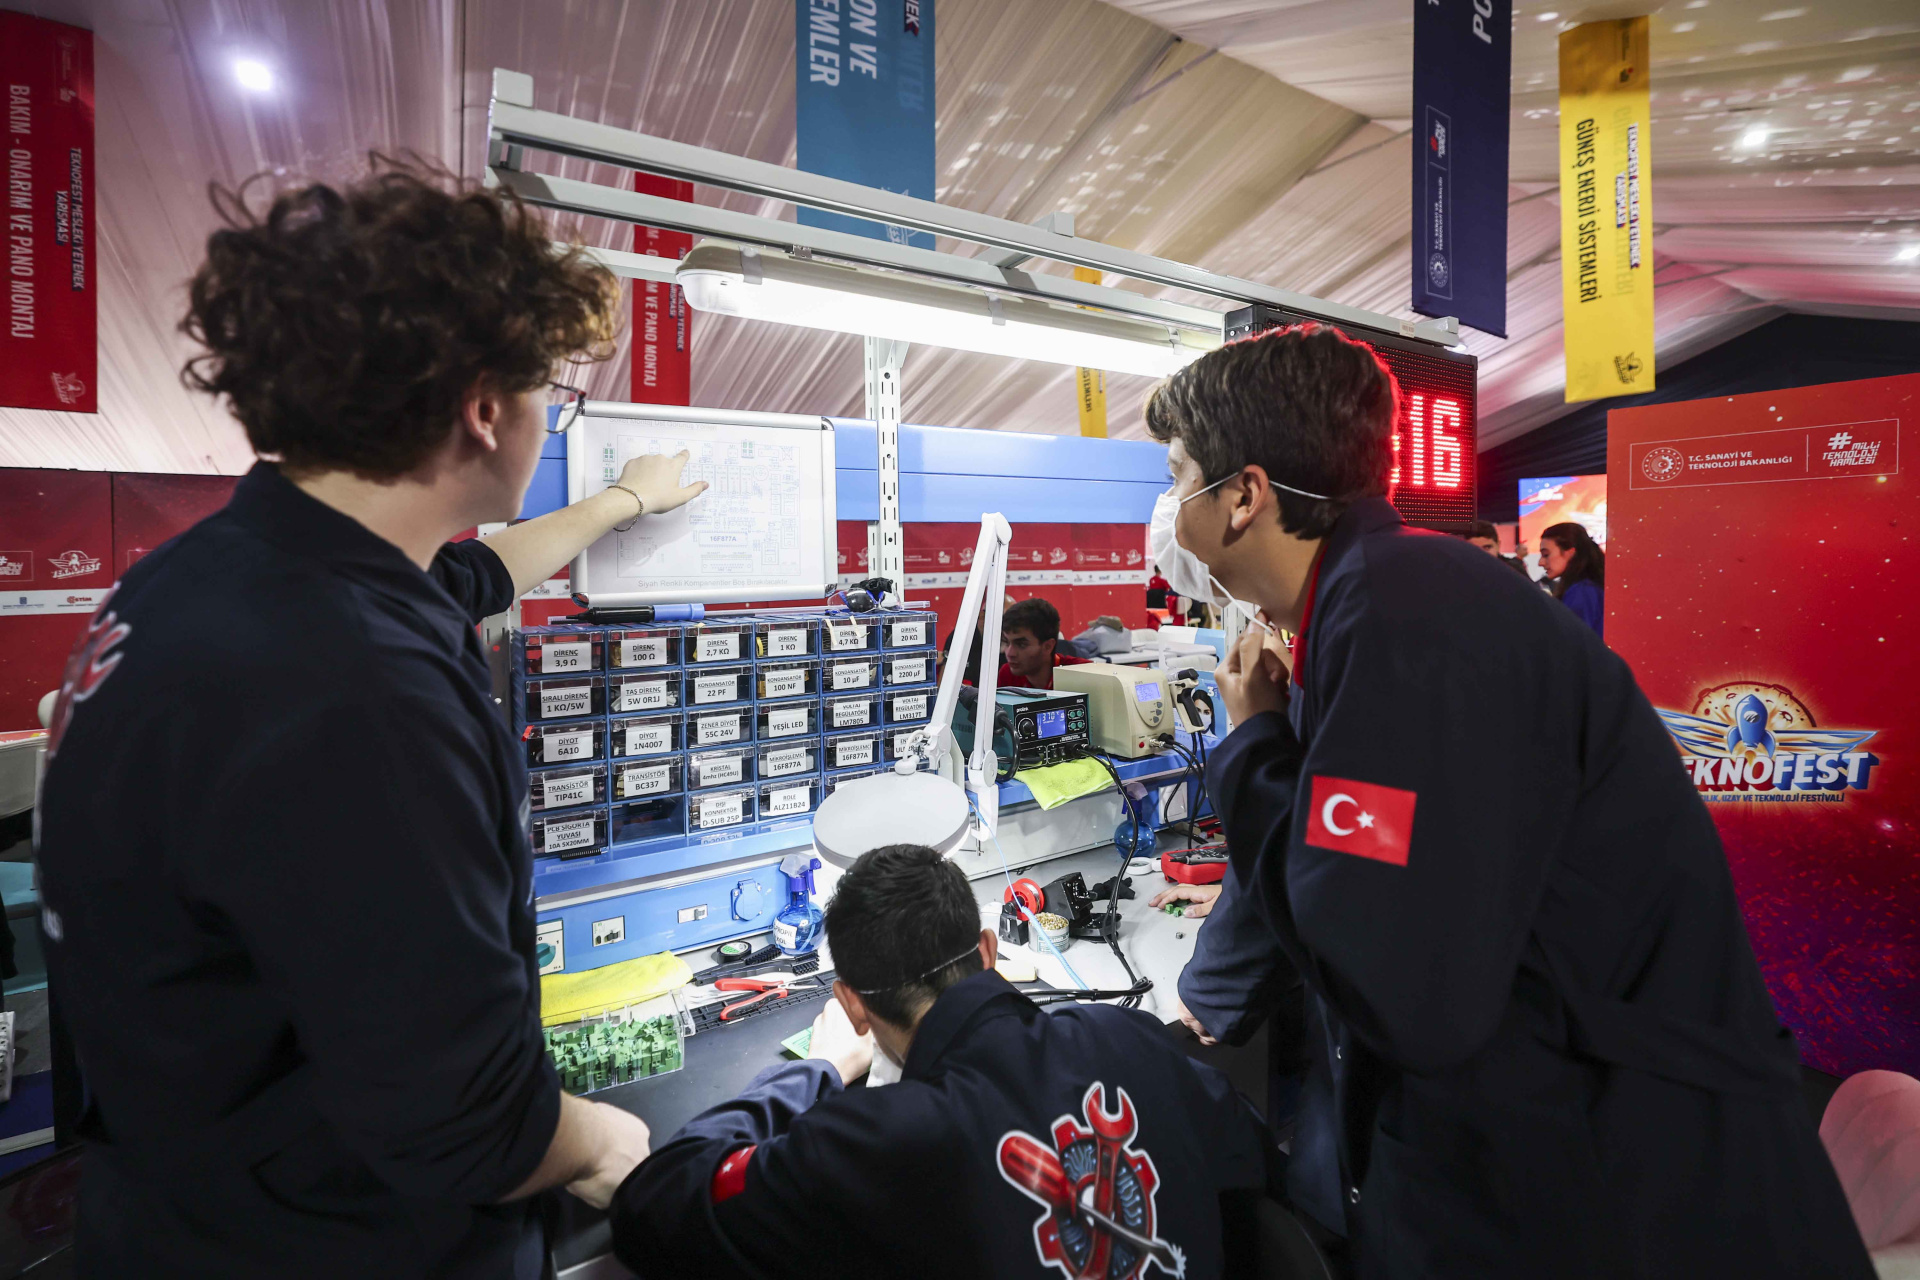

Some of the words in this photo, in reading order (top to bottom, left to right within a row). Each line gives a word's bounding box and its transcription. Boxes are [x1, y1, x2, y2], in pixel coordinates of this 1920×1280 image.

[849, 43, 877, 79] VE
[9, 85, 31, 133] BAKIM
[1573, 118, 1597, 168] GÜNEŞ
[9, 149, 32, 208] ONARIM
[70, 148, 82, 202] TEKNOFEST
[1576, 171, 1599, 218] ENERJİ
[10, 215, 33, 231] VE
[10, 235, 33, 276] PANO
[73, 246, 84, 288] YETENEK
[1579, 223, 1603, 303] SİSTEMLERİ
[645, 296, 658, 310] VE
[11, 280, 34, 338] MONTAJ
[644, 312, 658, 341] PANO
[643, 344, 657, 387] MONTAJ
[1705, 451, 1738, 461] SANAYİ
[1689, 459, 1738, 470] TEKNOLOJİ
[1740, 456, 1792, 467] BAKANLIĞI
[638, 580, 658, 588] Siyah
[632, 643, 656, 651] DİRENÇ
[707, 639, 728, 648] DİRENÇ
[553, 648, 579, 657] DİRENÇ
[633, 653, 647, 661] 100
[706, 648, 717, 656] 2,7
[555, 659, 569, 667] 3,9
[898, 671, 912, 679] 2200
[626, 688, 638, 696] TAŞ
[639, 686, 661, 695] DİRENÇ
[773, 683, 785, 692] 100
[786, 682, 796, 690] NF
[707, 689, 717, 697] 22
[718, 688, 727, 696] PF
[627, 697, 641, 705] 5W
[1042, 712, 1055, 721] 370
[701, 721, 719, 729] ZENER
[720, 719, 737, 727] DİYOT
[773, 722, 790, 731] YEŞİL
[792, 721, 804, 729] LED
[639, 732, 658, 740] DİYOT
[719, 728, 734, 737] 24V
[558, 737, 578, 746] DİYOT
[634, 741, 663, 750] 1N4007
[558, 746, 579, 755] 6A10
[842, 752, 868, 761] 16F877A
[773, 761, 801, 771] 16F877A
[1683, 752, 1870, 787] KNOFEST
[635, 781, 659, 790] BC337
[554, 790, 583, 802] TIP41C
[1755, 794, 1800, 802] TEKNOLOJİ
[1801, 793, 1845, 802] FESTİVALİ
[702, 818, 725, 827] D-SUB
[727, 815, 740, 823] 25P
[557, 831, 581, 840] YUVASI
